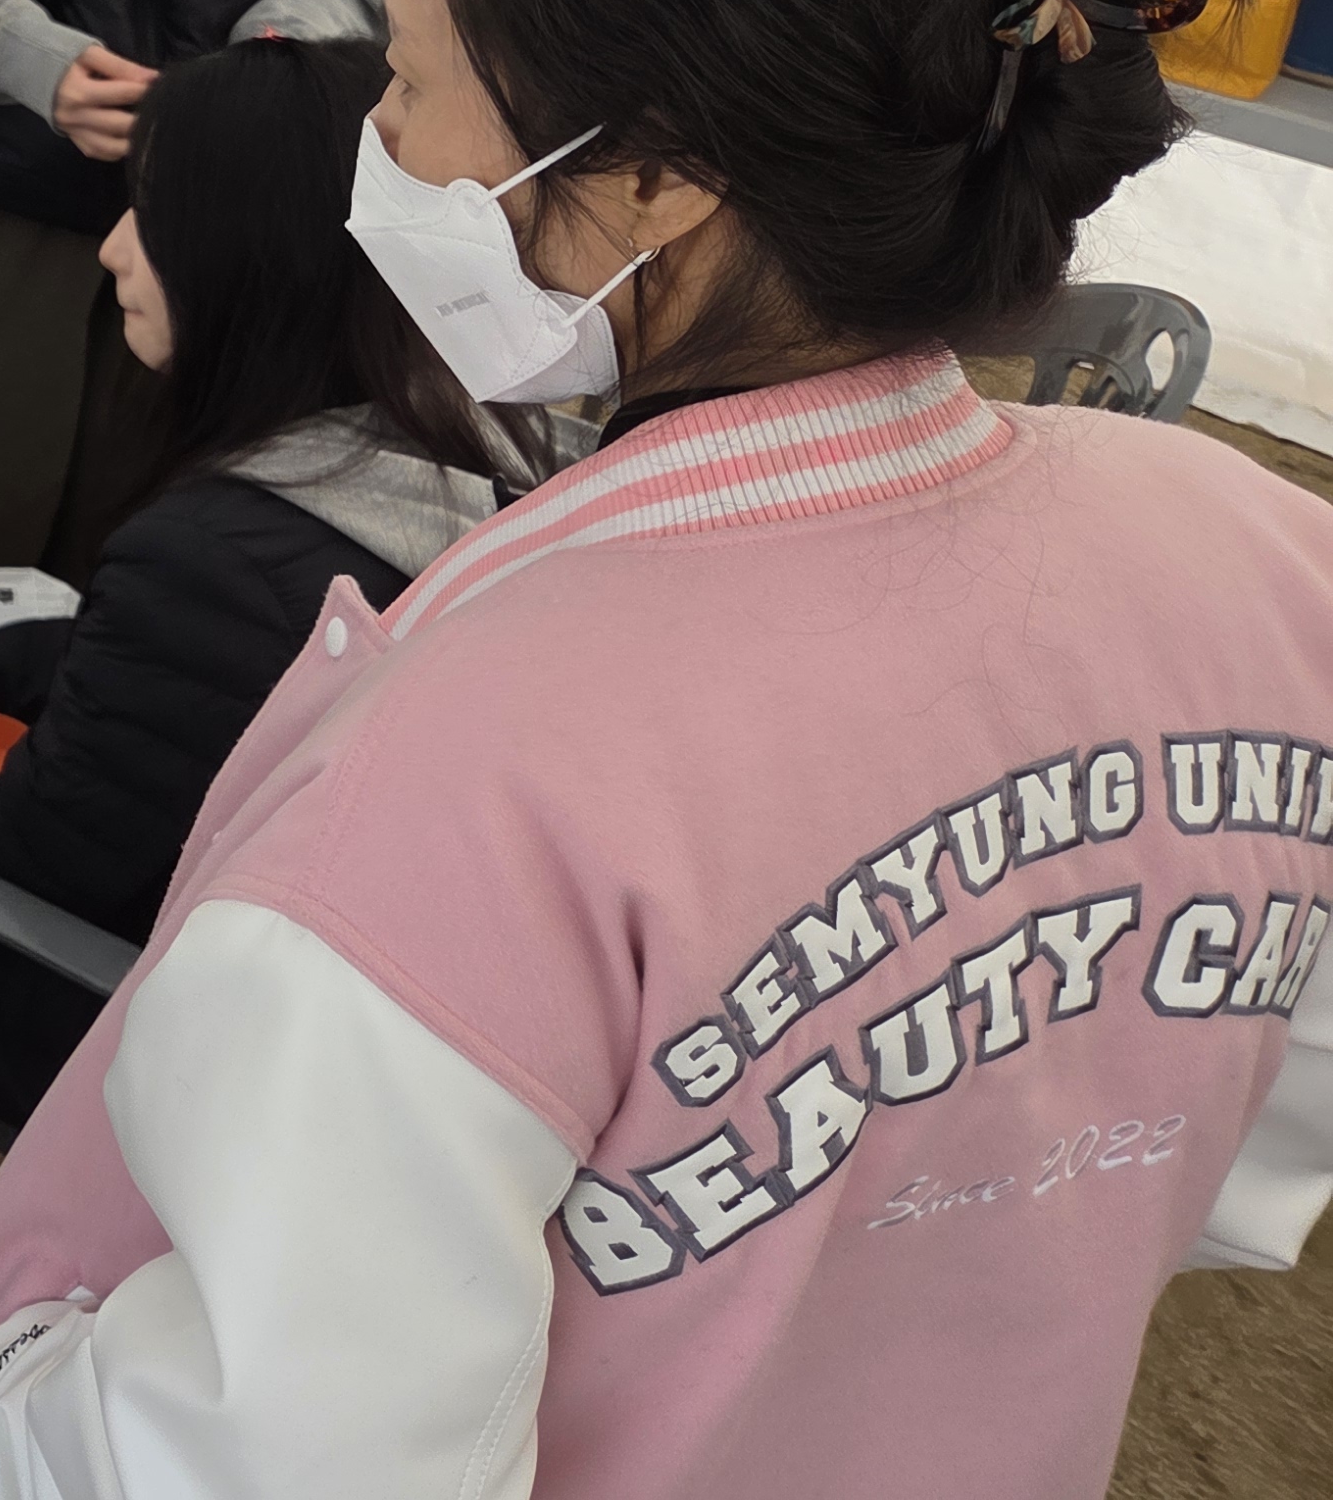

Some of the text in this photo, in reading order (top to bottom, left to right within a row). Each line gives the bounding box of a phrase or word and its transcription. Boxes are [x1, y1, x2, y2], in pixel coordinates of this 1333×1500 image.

[556, 883, 1142, 1296] BEAUTY
[650, 738, 1144, 1106] SEMYUNG
[866, 1113, 1187, 1230] Since 2022
